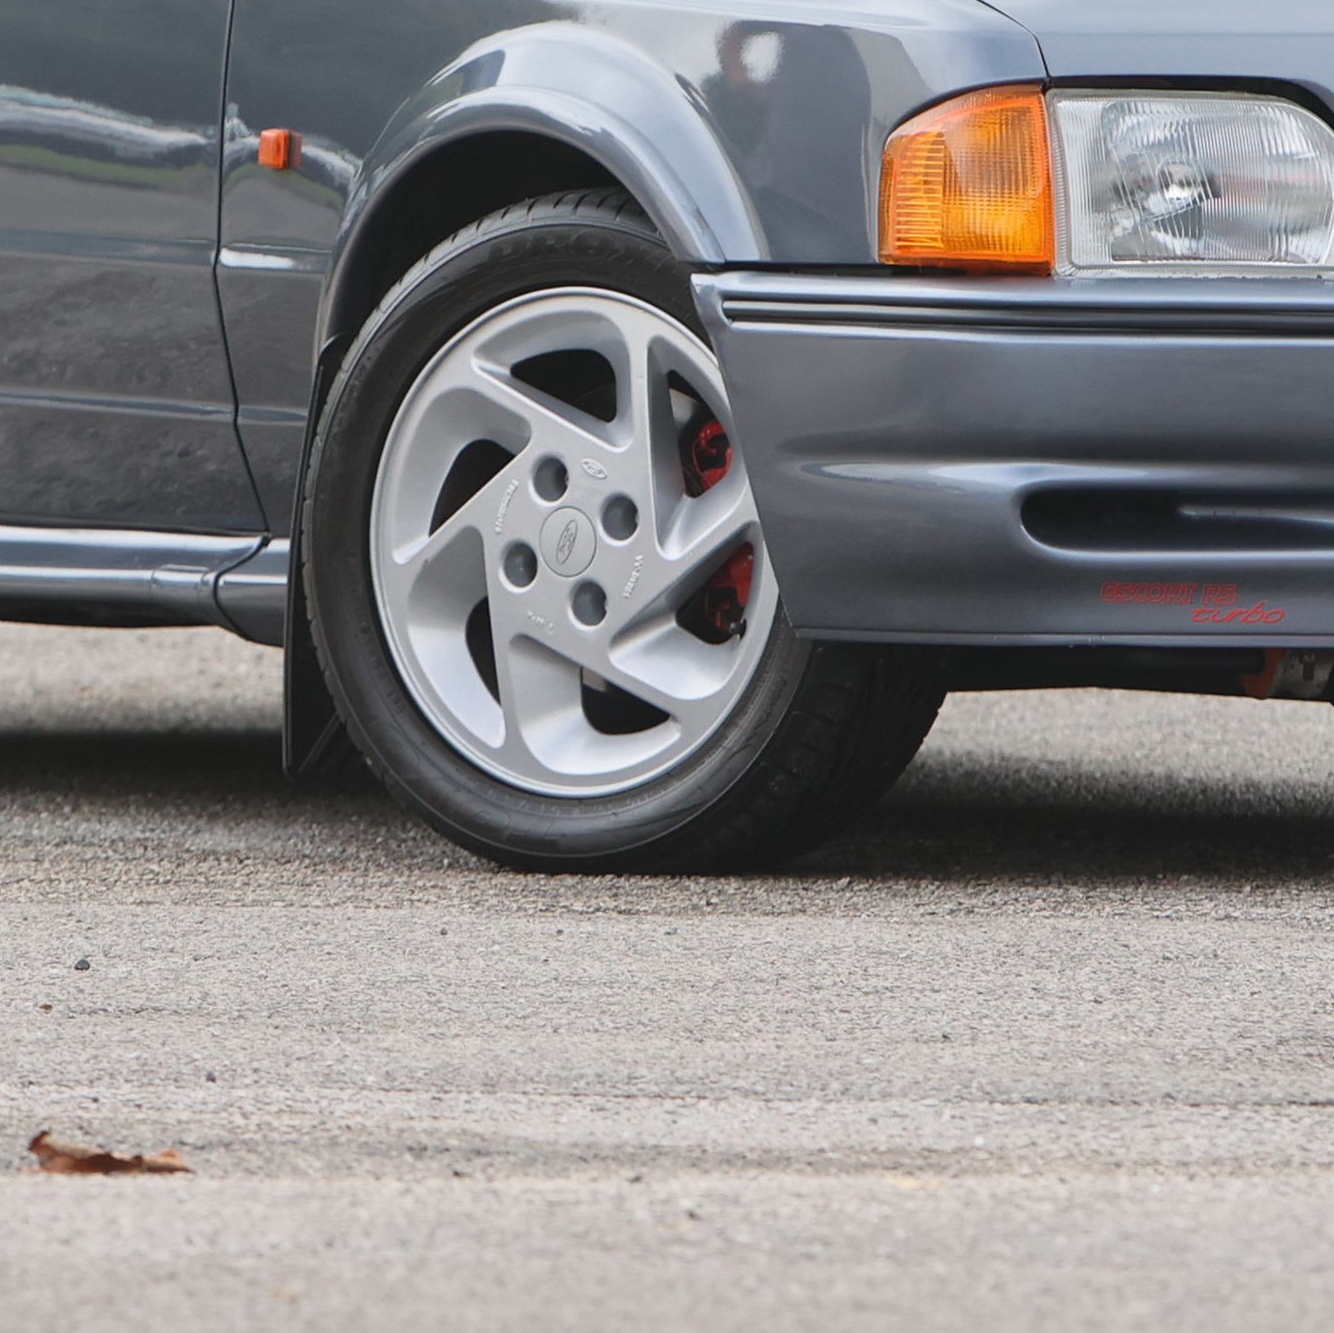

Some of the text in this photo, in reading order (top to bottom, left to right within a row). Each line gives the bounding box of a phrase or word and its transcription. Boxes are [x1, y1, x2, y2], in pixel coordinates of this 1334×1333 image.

[1100, 581, 1239, 605] ESCORT RS
[1191, 599, 1286, 624] turbo
